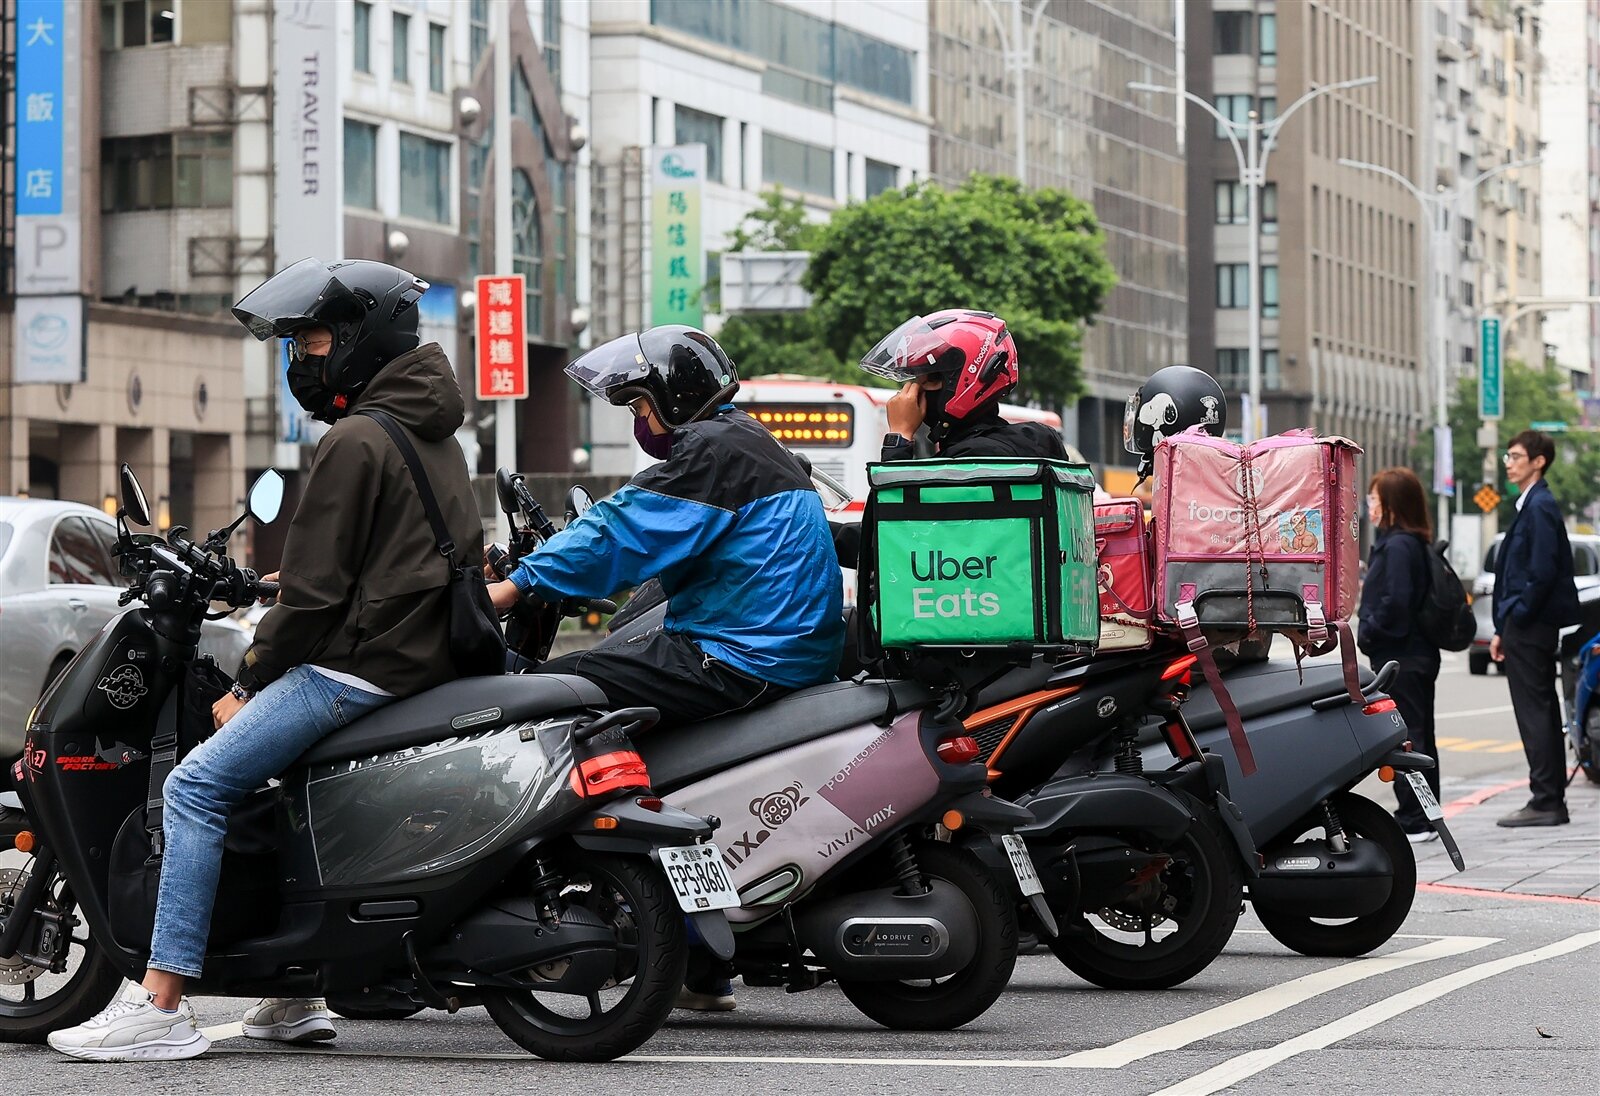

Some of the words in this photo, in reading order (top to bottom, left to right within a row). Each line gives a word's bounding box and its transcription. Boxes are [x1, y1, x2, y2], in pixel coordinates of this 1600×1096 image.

[303, 53, 319, 196] TRAVELER
[35, 224, 67, 268] P
[668, 190, 689, 312] 陽信銀行
[488, 281, 514, 393] 減速進站
[911, 550, 998, 581] Uber
[912, 587, 1001, 619] Eats
[864, 804, 897, 831] MIX
